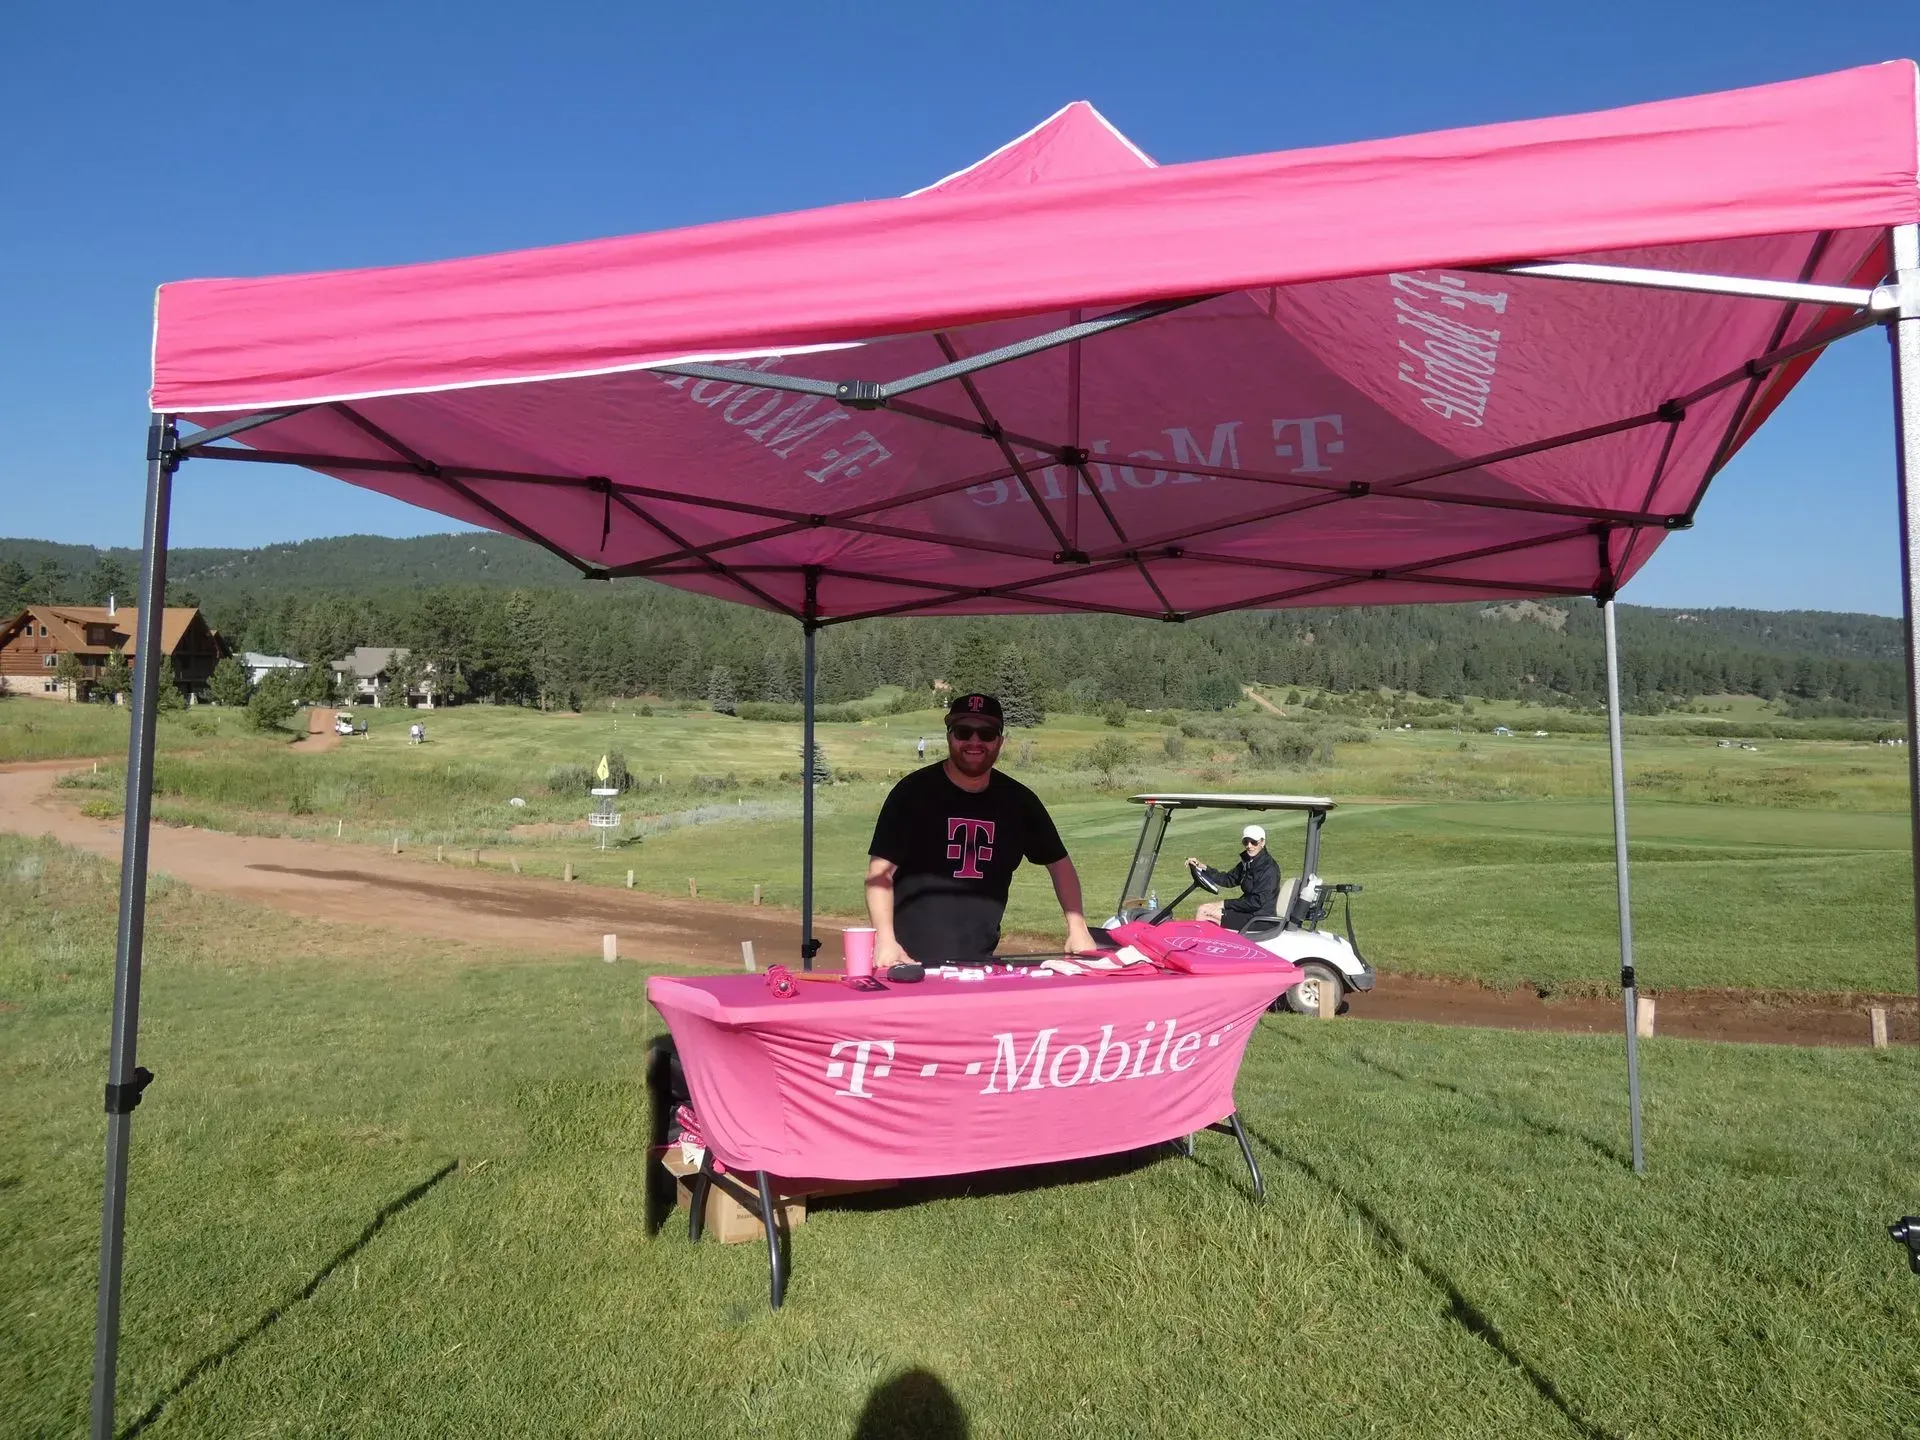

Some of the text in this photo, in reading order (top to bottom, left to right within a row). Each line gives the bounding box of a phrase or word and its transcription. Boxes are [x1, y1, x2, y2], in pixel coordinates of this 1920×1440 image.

[947, 818, 995, 878] T
[826, 1018, 1202, 1098] T Mobile
